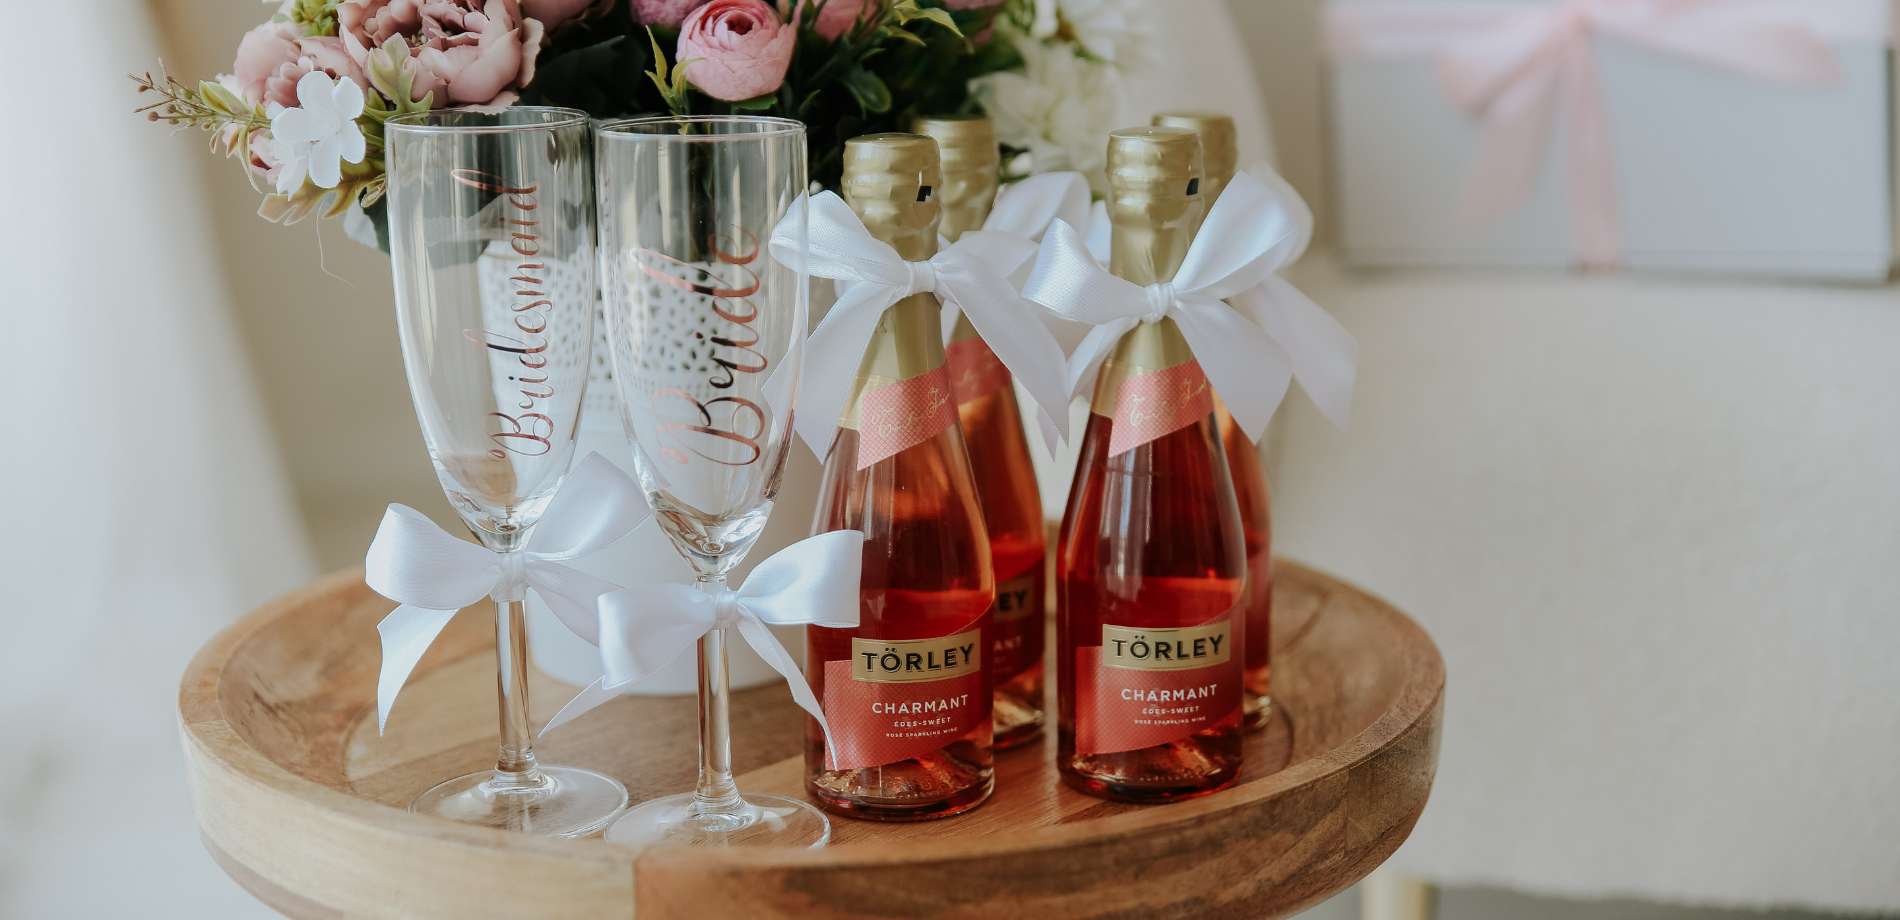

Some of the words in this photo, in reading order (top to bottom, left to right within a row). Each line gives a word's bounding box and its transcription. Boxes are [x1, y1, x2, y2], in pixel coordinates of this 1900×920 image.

[451, 168, 555, 463] Bridesmaid
[629, 223, 768, 471] Bride
[861, 643, 975, 673] TÖRLEY
[1111, 634, 1224, 660] TÖRLEY
[871, 694, 968, 714] CHARMANT
[1121, 684, 1217, 702] CHARMANT
[905, 730, 941, 738] SPARKLING
[942, 726, 958, 734] WINE
